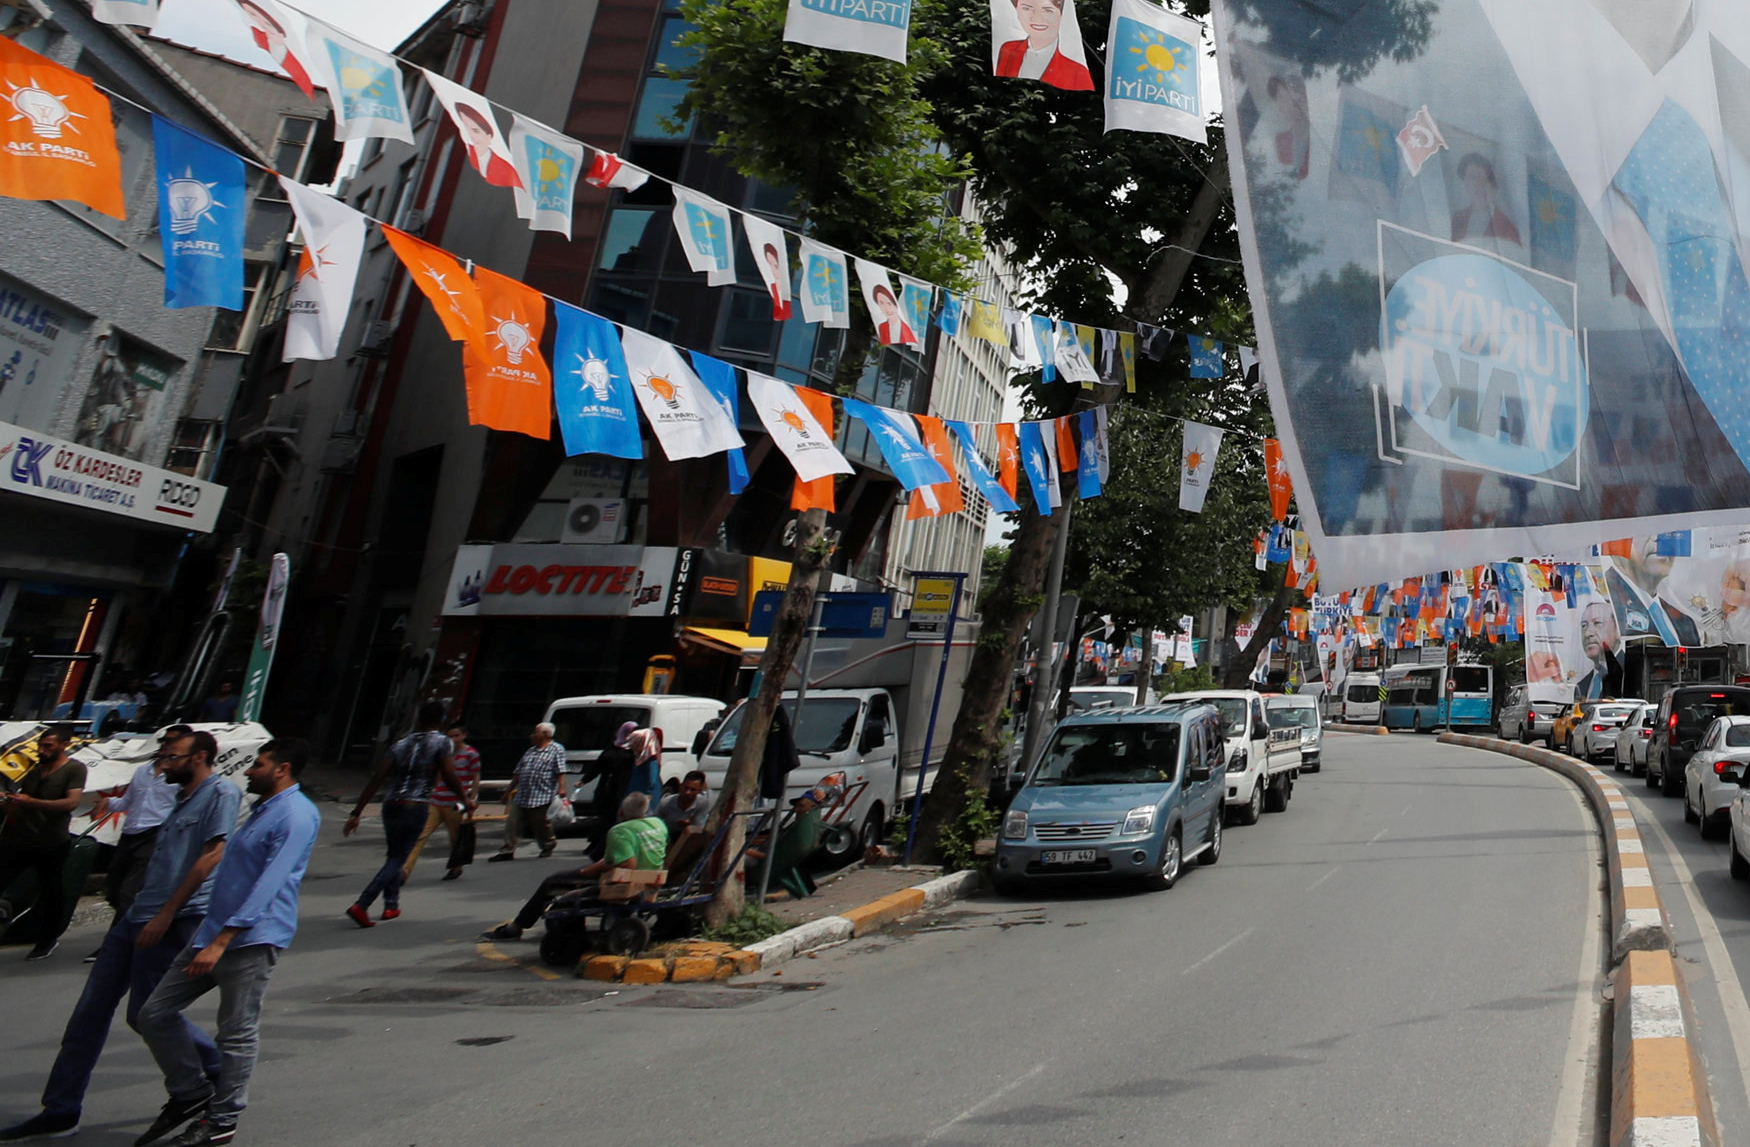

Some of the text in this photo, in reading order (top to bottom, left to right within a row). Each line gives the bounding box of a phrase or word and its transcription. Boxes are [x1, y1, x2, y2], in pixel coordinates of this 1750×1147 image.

[7, 141, 36, 151] AK
[583, 405, 598, 413] AK
[484, 564, 638, 595] LOCTITE
